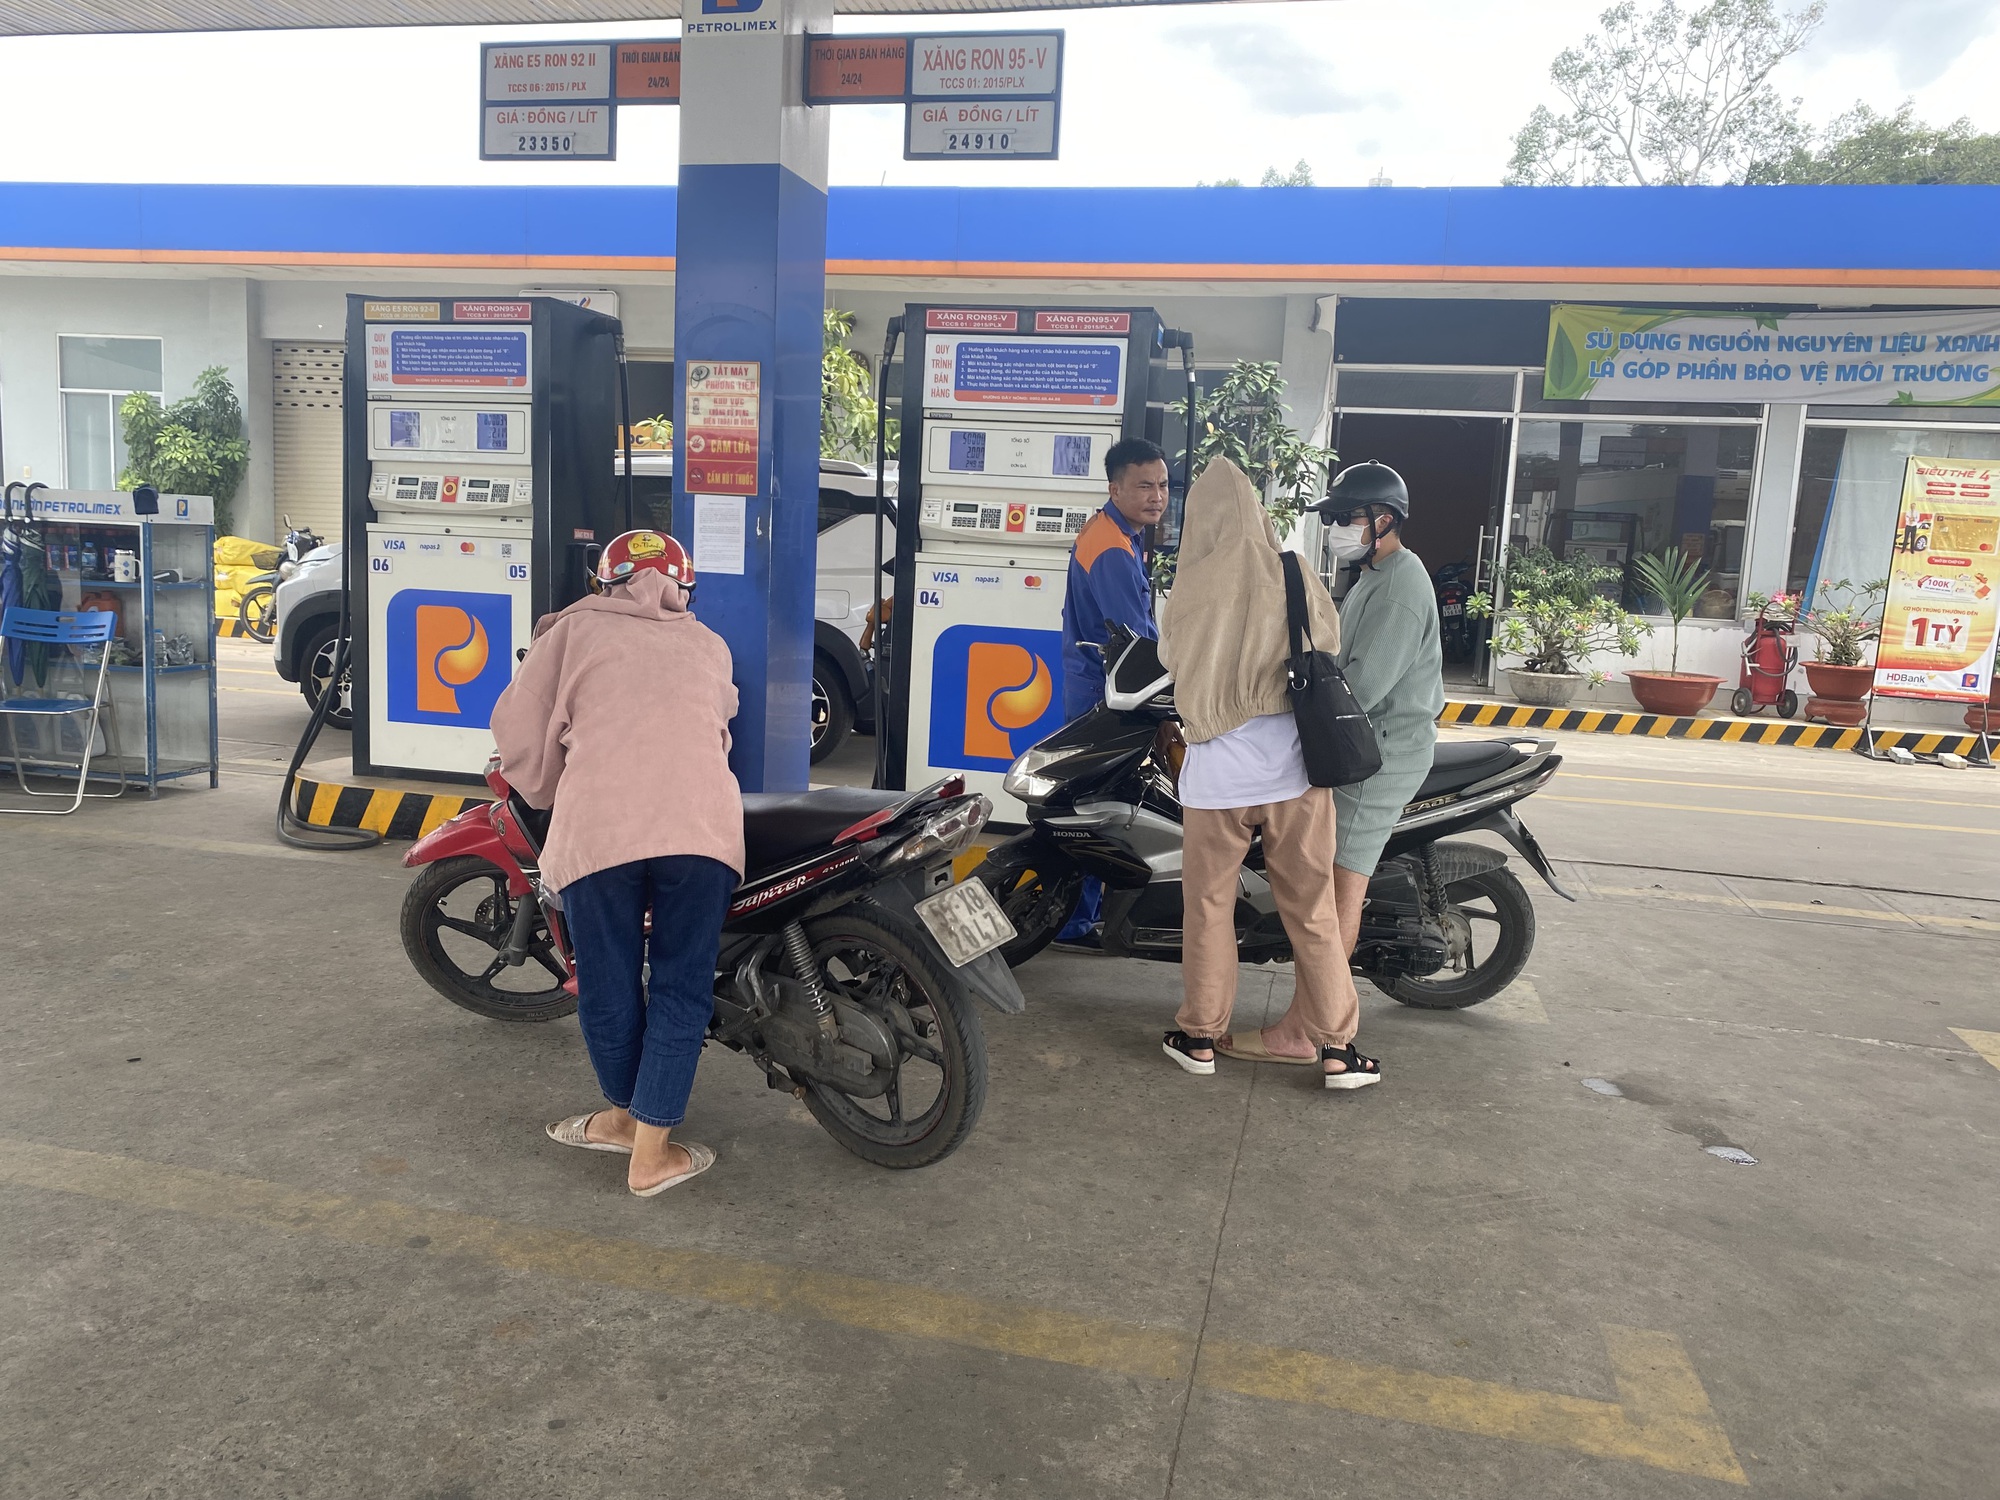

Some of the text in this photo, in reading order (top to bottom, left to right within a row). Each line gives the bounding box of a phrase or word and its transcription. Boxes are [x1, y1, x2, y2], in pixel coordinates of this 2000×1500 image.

[687, 20, 777, 34] PETROLIMEX
[641, 51, 661, 63] GIAN
[837, 48, 857, 61] GIAN
[859, 46, 878, 60] BÁN
[880, 44, 905, 59] HÀNG
[923, 45, 966, 71] XĂNG
[971, 48, 1004, 71] RON
[1008, 48, 1025, 70] 95
[1036, 47, 1047, 69] V
[494, 53, 596, 69] XĂNG E5 RON 92 II
[648, 76, 670, 88] 24/24
[841, 73, 862, 85] 24/24
[940, 78, 965, 89] TCCS
[983, 77, 1025, 89] 2015/PLX
[508, 83, 527, 93] TCCS
[546, 82, 564, 92] 2015
[571, 82, 587, 91] PLX
[528, 107, 566, 124] ĐỒNG
[578, 110, 598, 123] LÍT
[923, 106, 948, 122] GIÁ
[958, 105, 1002, 122] ĐỒNG
[1016, 106, 1039, 122] LÍT
[518, 136, 571, 151] 23350
[949, 134, 1009, 150] 24910
[1585, 327, 2000, 356] SỬ DỤNG NGUỒN NGUYÊN LIỆU XANH
[936, 344, 950, 354] QUY
[931, 357, 952, 369] TRÌNH
[731, 366, 749, 376] MÁY
[934, 372, 948, 383] BÁN
[1589, 357, 1989, 385] LÀ GÓP PHẦN BẢO VỆ MÔI TRƯỜNG
[931, 387, 950, 398] HÀNG
[44, 501, 121, 515] PETROLIMEX
[383, 540, 406, 550] VISA
[373, 558, 389, 571] 06
[509, 565, 527, 578] 05
[933, 572, 959, 583] VISA
[1928, 579, 1949, 588] 100K
[920, 591, 939, 605] 04
[1912, 617, 1963, 646] 1 TỶ
[1886, 673, 1925, 683] HDBank
